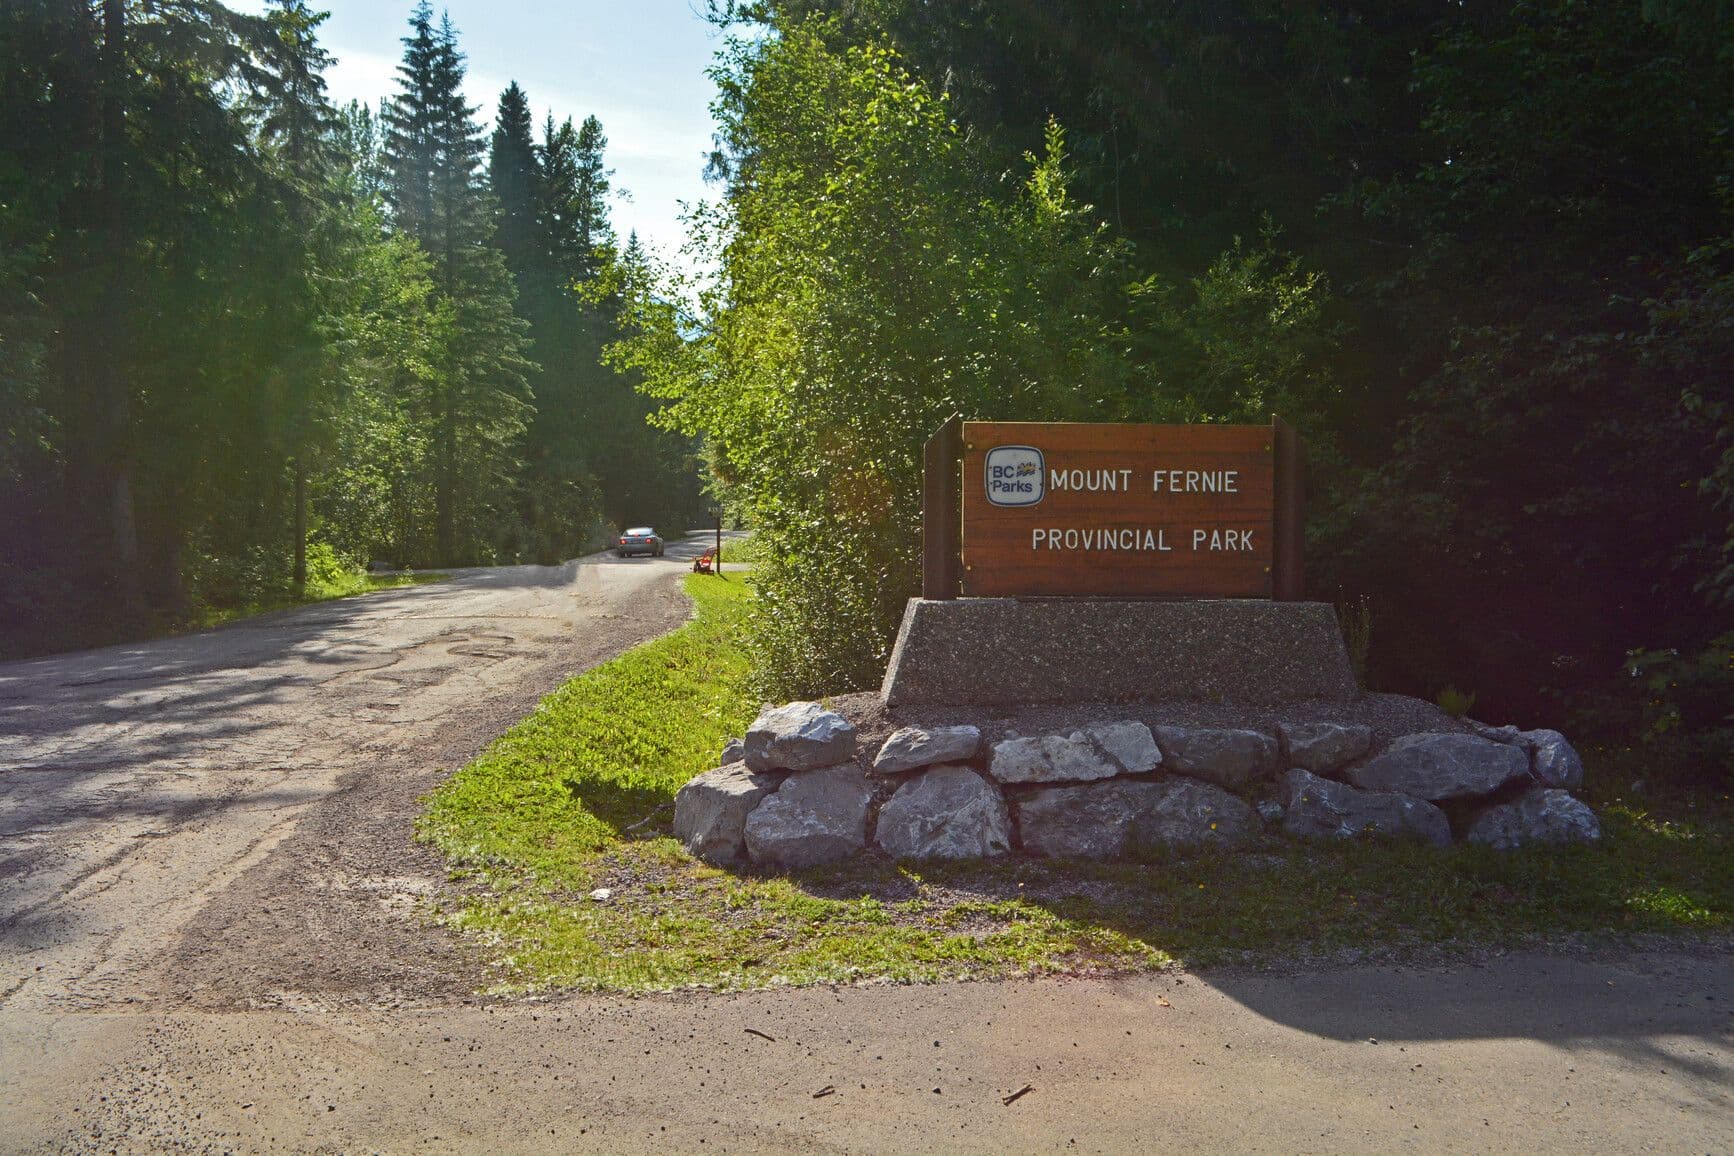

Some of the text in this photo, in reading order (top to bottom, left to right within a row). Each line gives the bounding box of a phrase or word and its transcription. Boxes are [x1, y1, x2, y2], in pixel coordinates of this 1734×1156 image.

[992, 465, 1014, 478] BC
[993, 480, 1033, 493] Parks
[1050, 469, 1239, 493] MOUNT FERNIE
[1032, 528, 1254, 551] PROVINCIAL PARK
